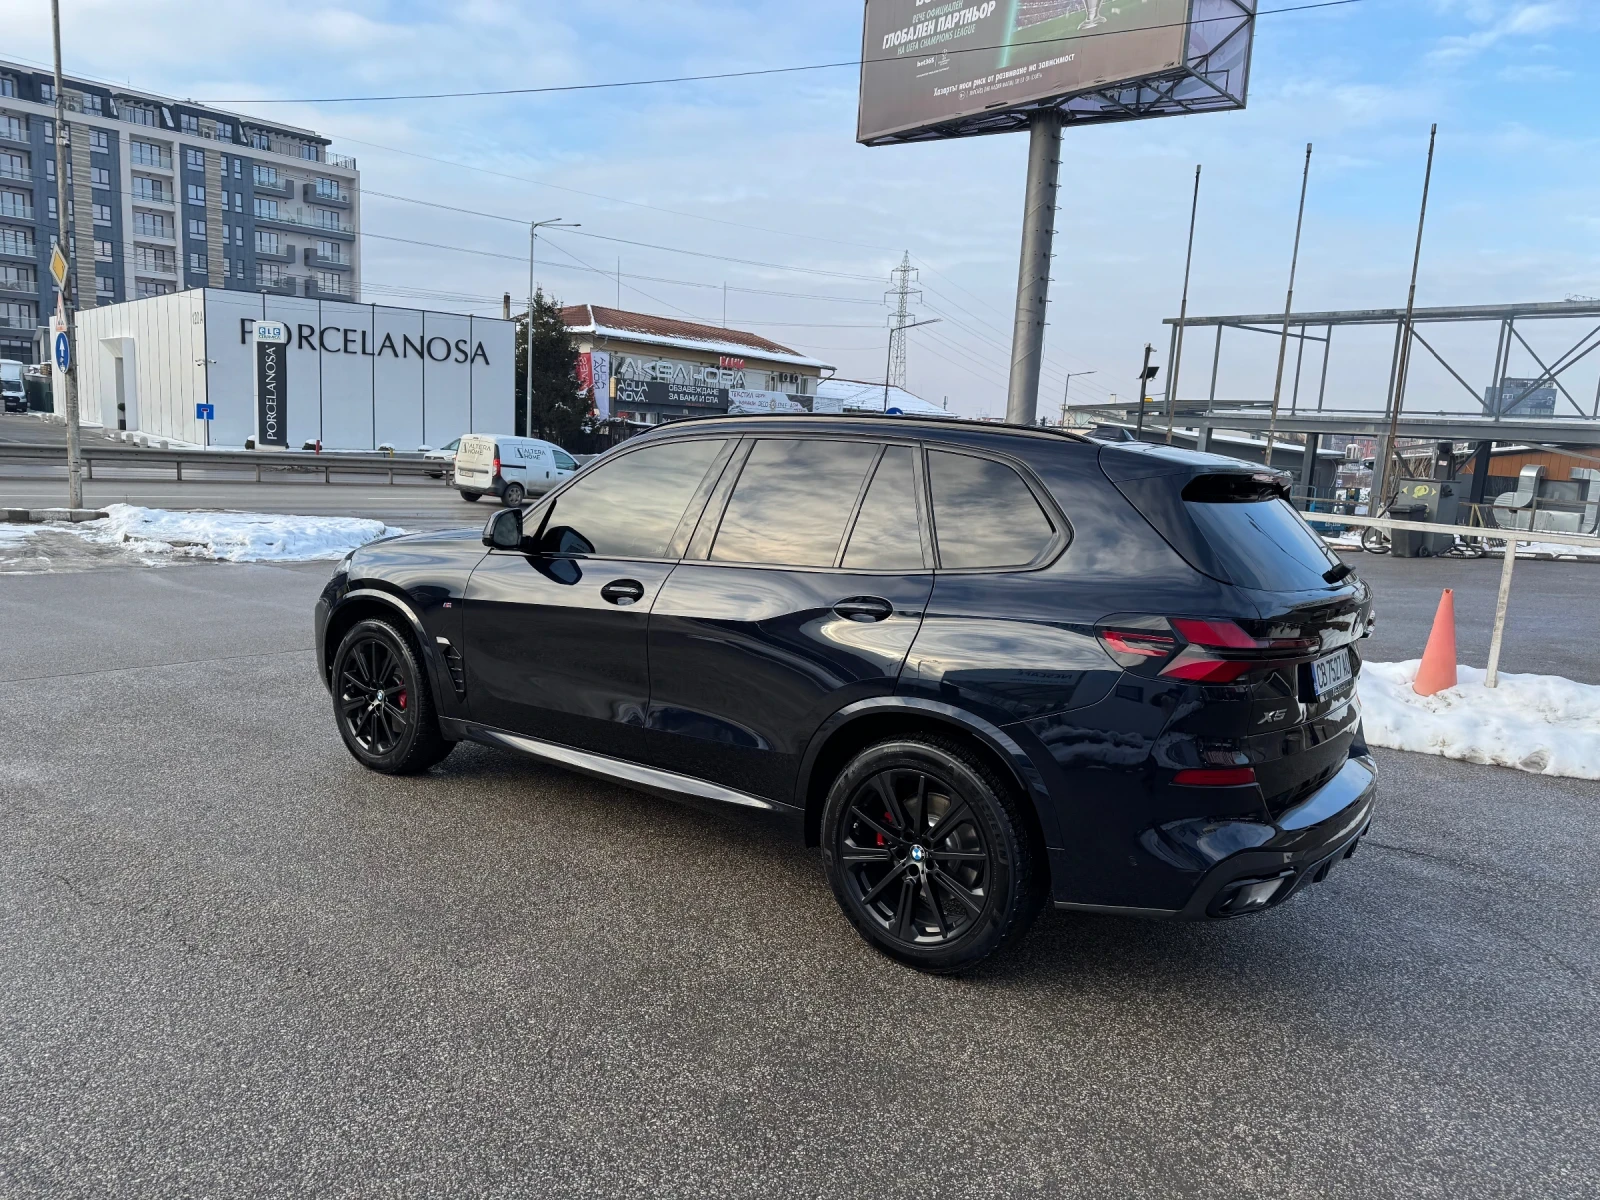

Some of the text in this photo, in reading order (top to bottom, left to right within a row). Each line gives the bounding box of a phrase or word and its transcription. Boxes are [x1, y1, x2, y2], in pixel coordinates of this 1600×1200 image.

[926, 0, 964, 19] ОФИЦИАЛЕН
[882, 1, 996, 49] ГЛОБАЛЕН ПАРТНЬОР
[906, 42, 919, 53] UEFA
[920, 31, 953, 49] CHAMPIONS
[954, 24, 976, 38] LEAGUE
[973, 78, 987, 89] риск
[995, 67, 1027, 83] развиване
[1038, 54, 1075, 70] зависимост
[265, 346, 278, 440] PORCELANOSA
[617, 380, 648, 391] AQUA
[668, 384, 719, 395] ОБЗАВЕЖДАНЕ
[680, 394, 698, 402] БАНИ
[469, 443, 491, 451] ALTERA
[1257, 708, 1288, 724] X5
